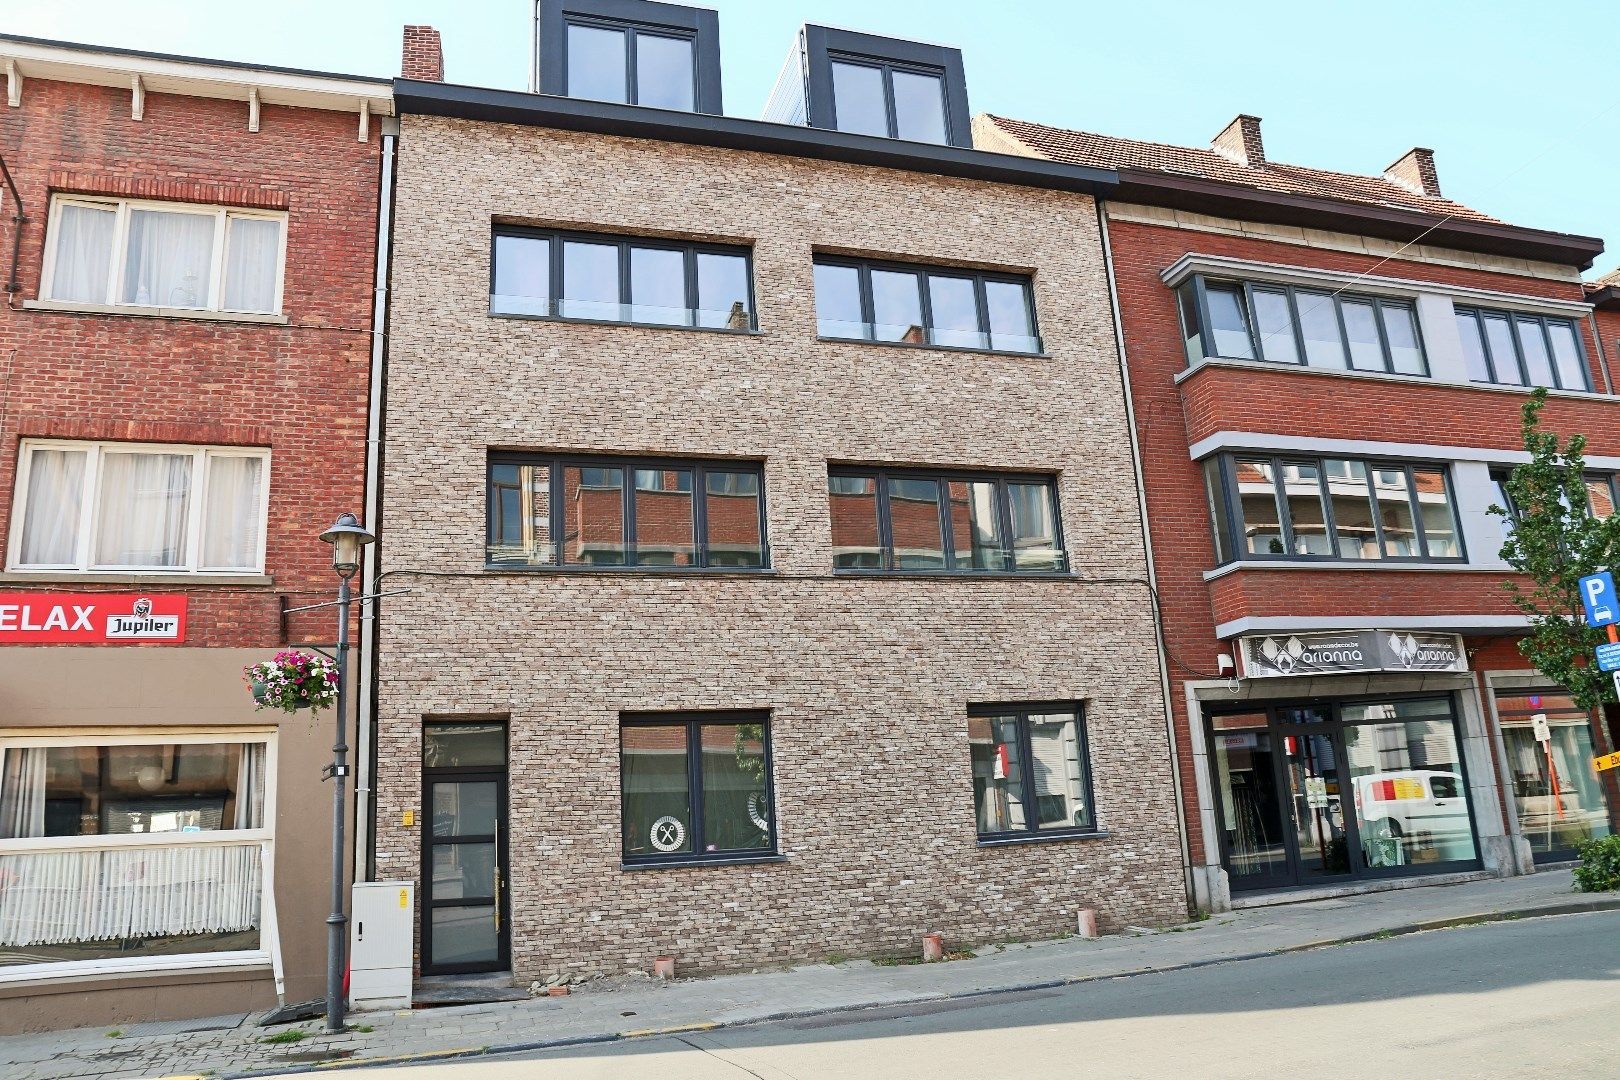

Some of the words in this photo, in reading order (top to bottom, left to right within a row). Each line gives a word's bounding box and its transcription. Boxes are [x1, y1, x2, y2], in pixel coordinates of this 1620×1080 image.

[1585, 578, 1605, 607] P
[0, 604, 97, 631] ELAX
[110, 618, 174, 635] Jupiler
[1302, 650, 1363, 664] arianna
[1416, 650, 1456, 661] arianna
